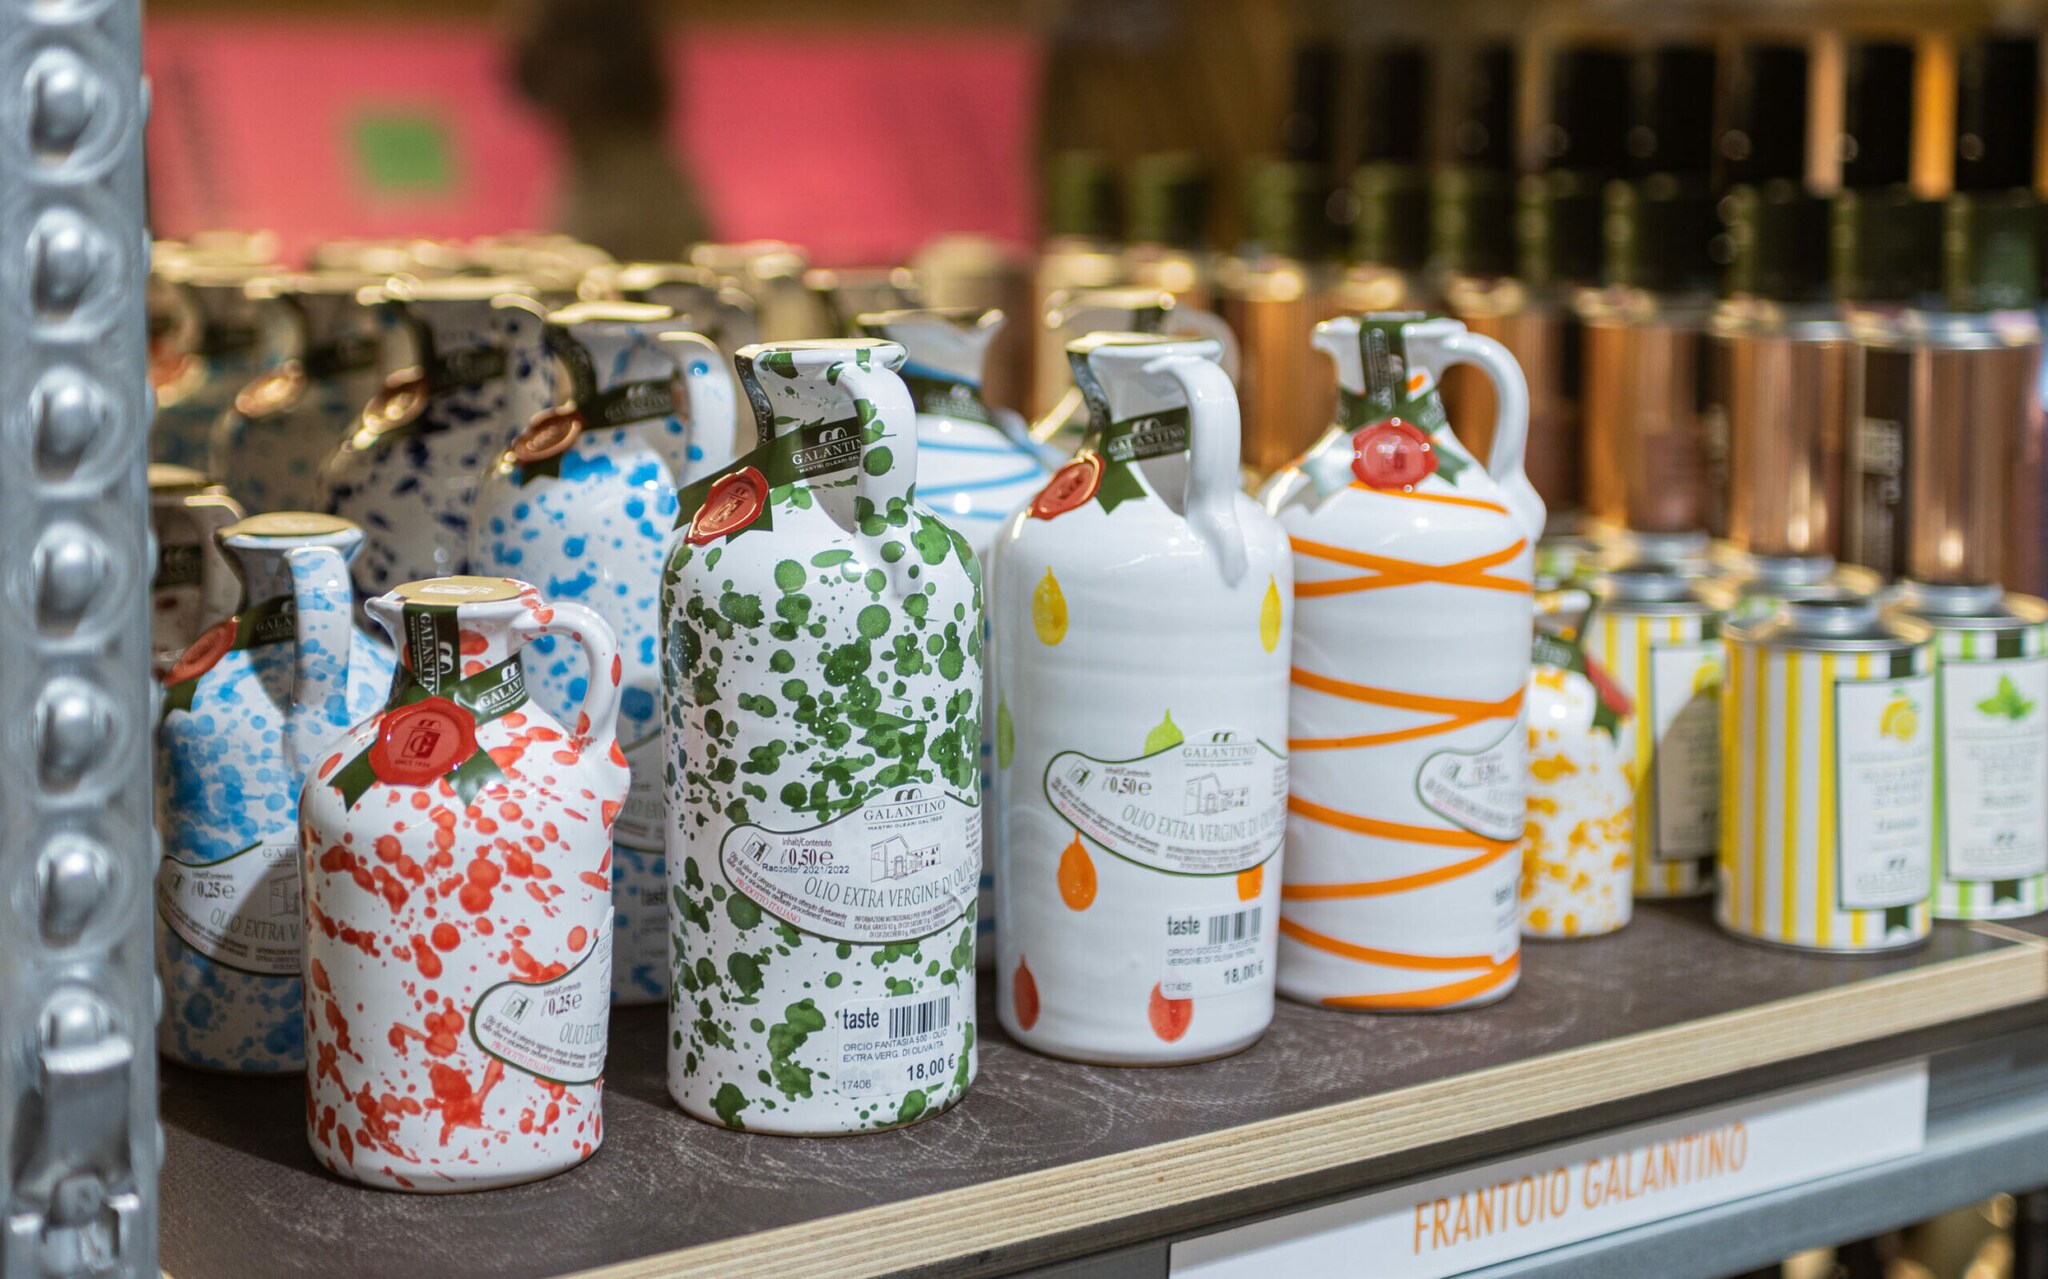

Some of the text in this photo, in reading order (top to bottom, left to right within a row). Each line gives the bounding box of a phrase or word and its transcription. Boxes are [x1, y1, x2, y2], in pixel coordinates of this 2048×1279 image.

[1182, 746, 1257, 759] GALANTINO
[863, 799, 946, 821] GALANTINO
[788, 847, 818, 868] 0,50
[804, 876, 840, 903] OLIO
[842, 886, 884, 908] EXTRA
[889, 880, 939, 908] VERGINE
[1167, 915, 1200, 936] taste
[843, 1007, 880, 1030] taste
[559, 1022, 584, 1045] OLIO
[843, 1042, 873, 1052] ORCIO
[874, 1035, 915, 1050] FANTASIA
[915, 1033, 928, 1044] 500
[932, 1028, 948, 1040] OLIO
[842, 1052, 873, 1063] EXTRA
[902, 1047, 910, 1057] DI
[906, 1053, 955, 1082] 18,00 €
[842, 1079, 872, 1090] 17406
[1413, 1122, 1748, 1255] FRANTOIO GALANTINO
